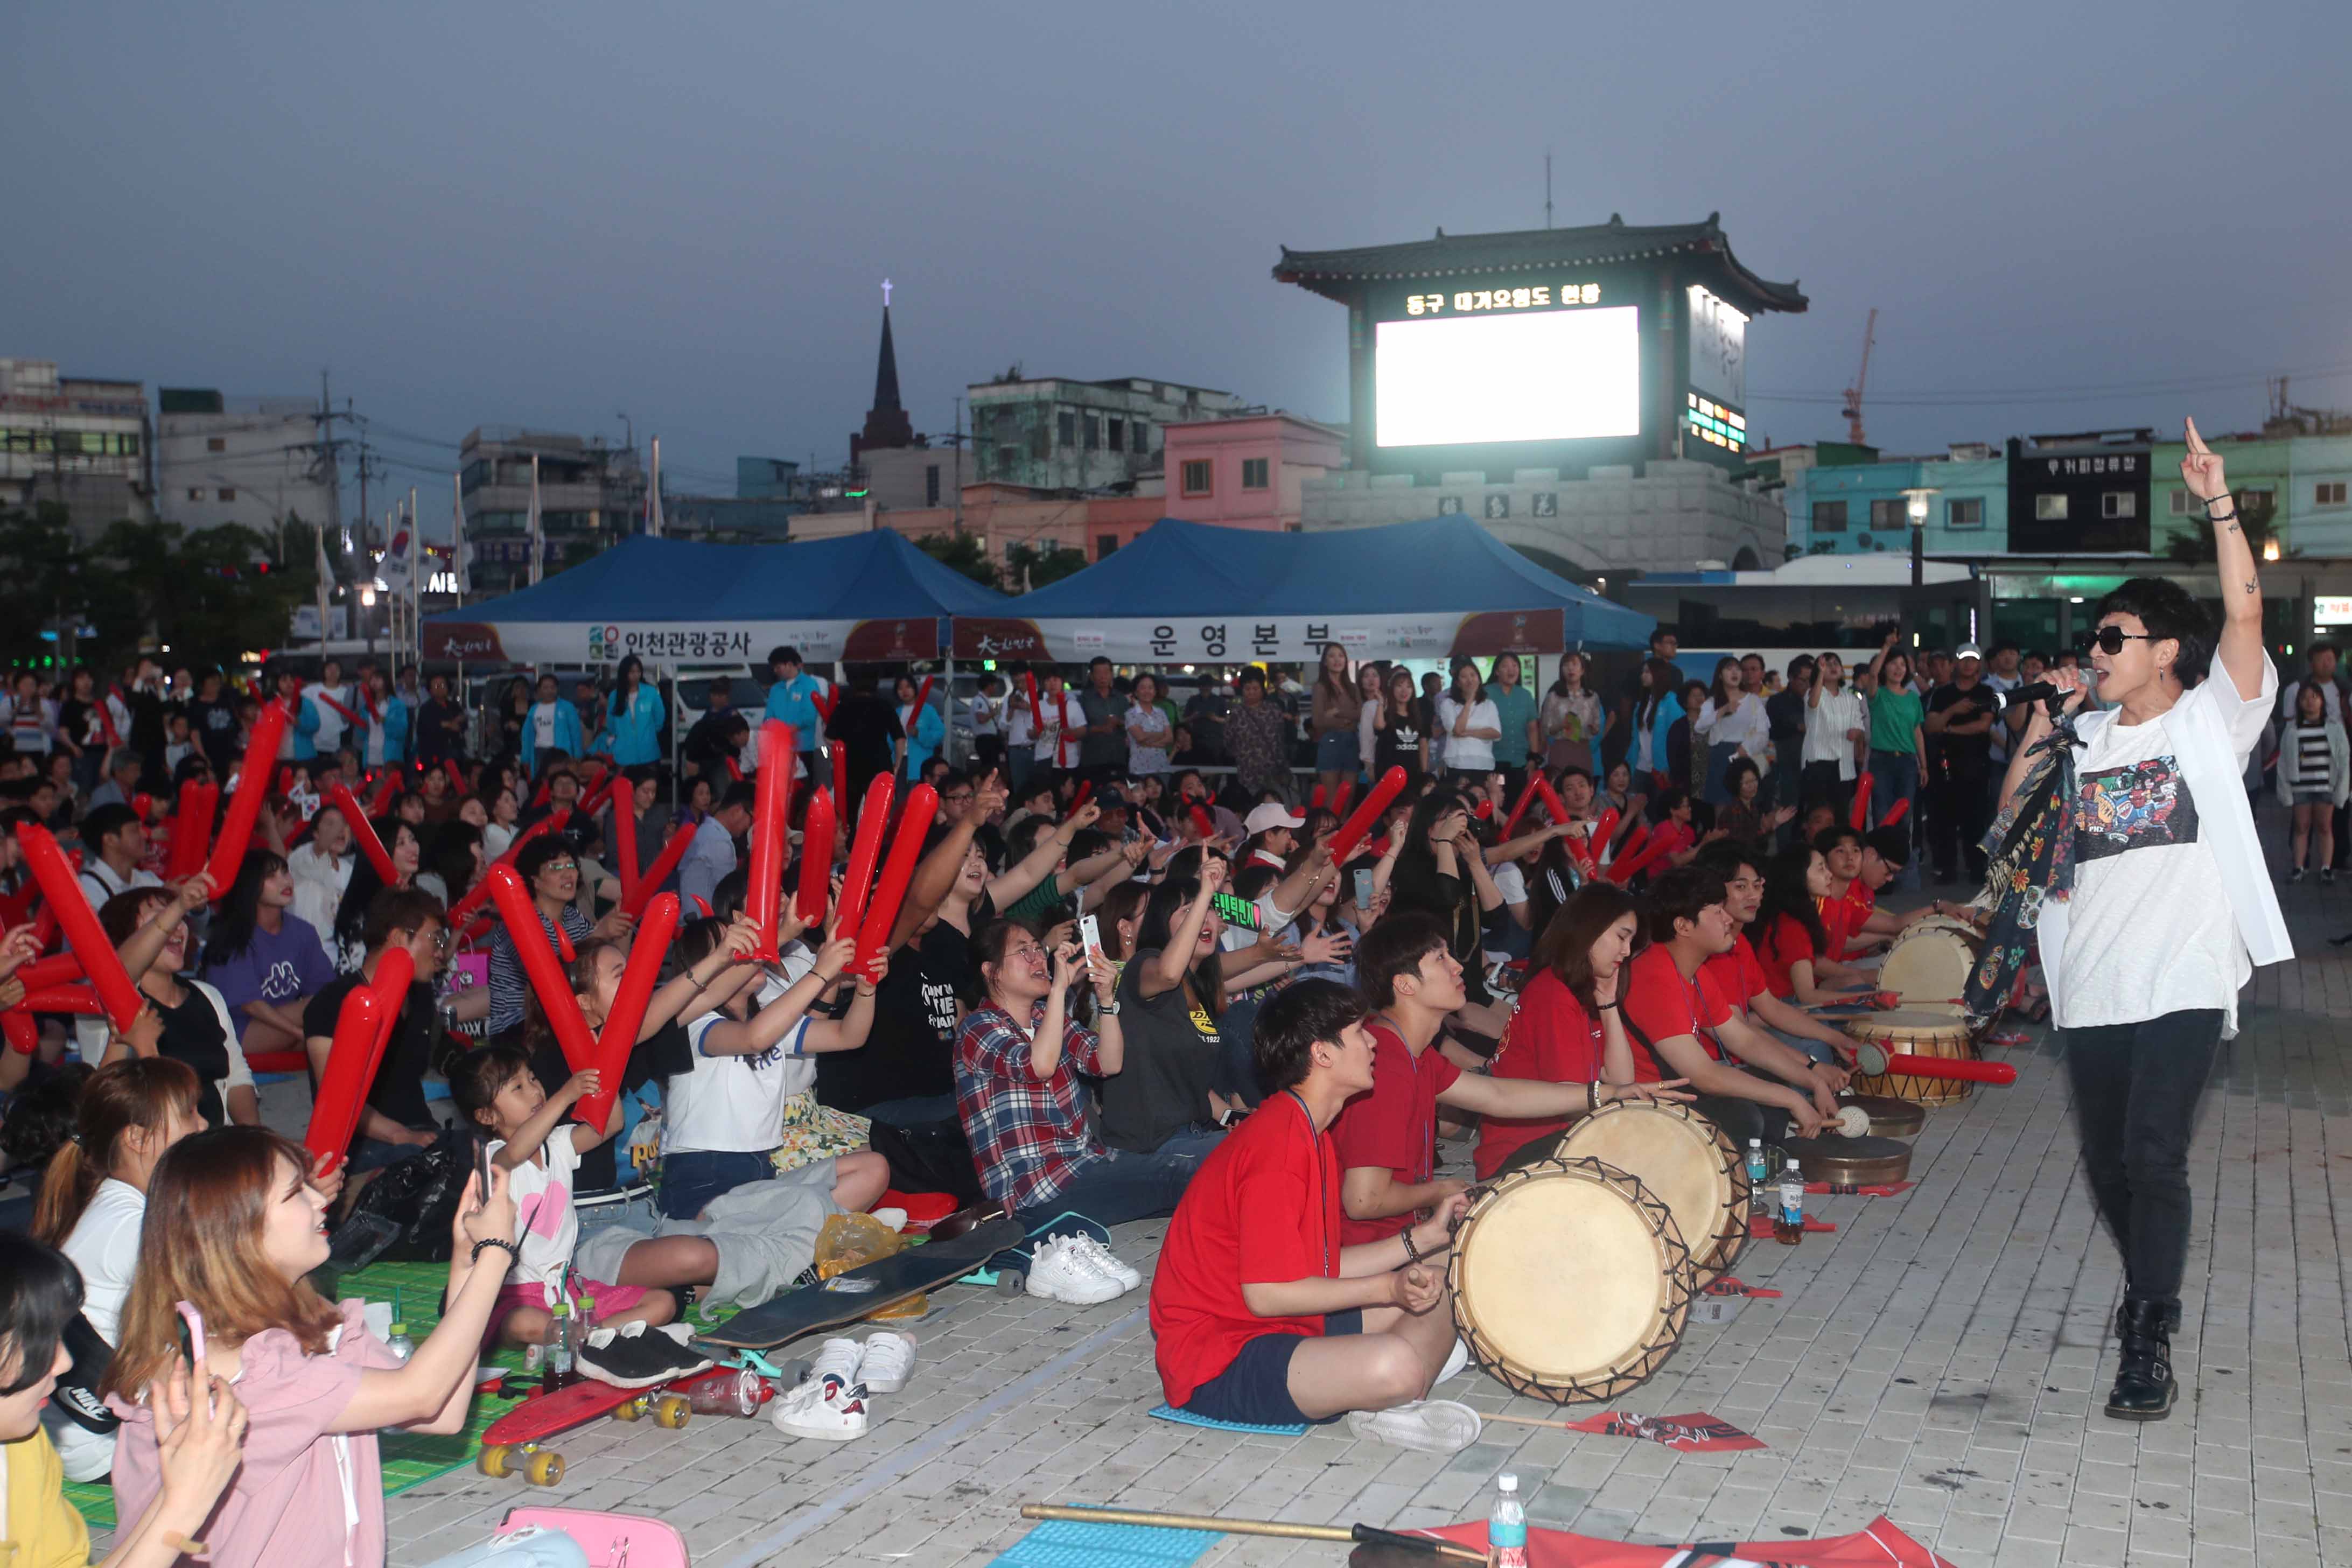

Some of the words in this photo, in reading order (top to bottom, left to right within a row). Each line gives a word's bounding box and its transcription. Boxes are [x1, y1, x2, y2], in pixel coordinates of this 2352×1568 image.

[1407, 294, 1444, 315] 동구
[1454, 286, 1551, 311] 대기오염도
[626, 631, 752, 657] 인천관광공사
[1150, 624, 1330, 656] 운영본부
[71, 1387, 110, 1417] NIKE
